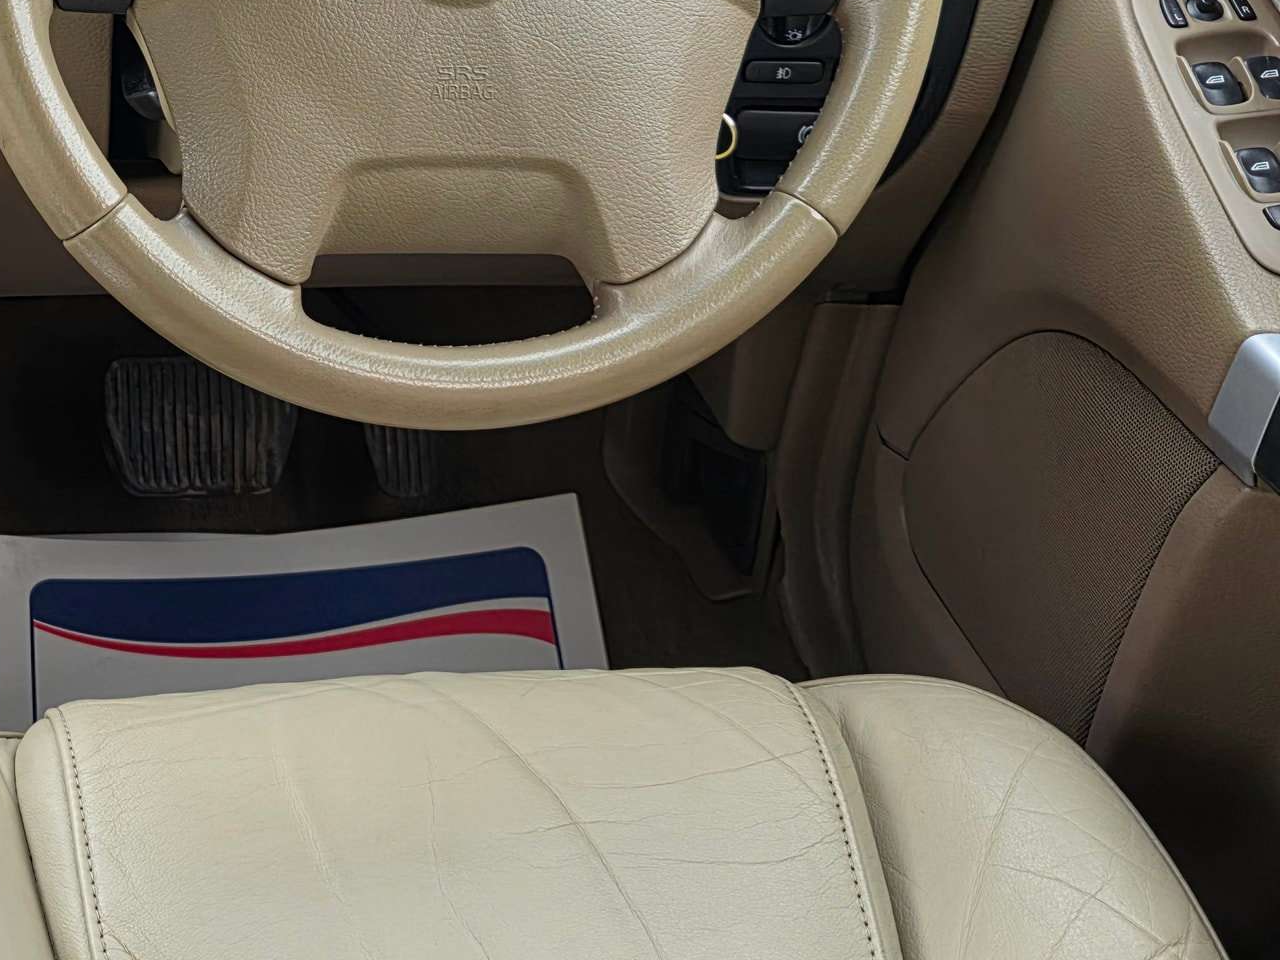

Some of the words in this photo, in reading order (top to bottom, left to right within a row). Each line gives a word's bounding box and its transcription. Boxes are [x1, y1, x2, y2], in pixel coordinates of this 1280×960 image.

[1241, 5, 1250, 14] R
[437, 65, 489, 81] SRS
[431, 83, 498, 101] AIRBAG
